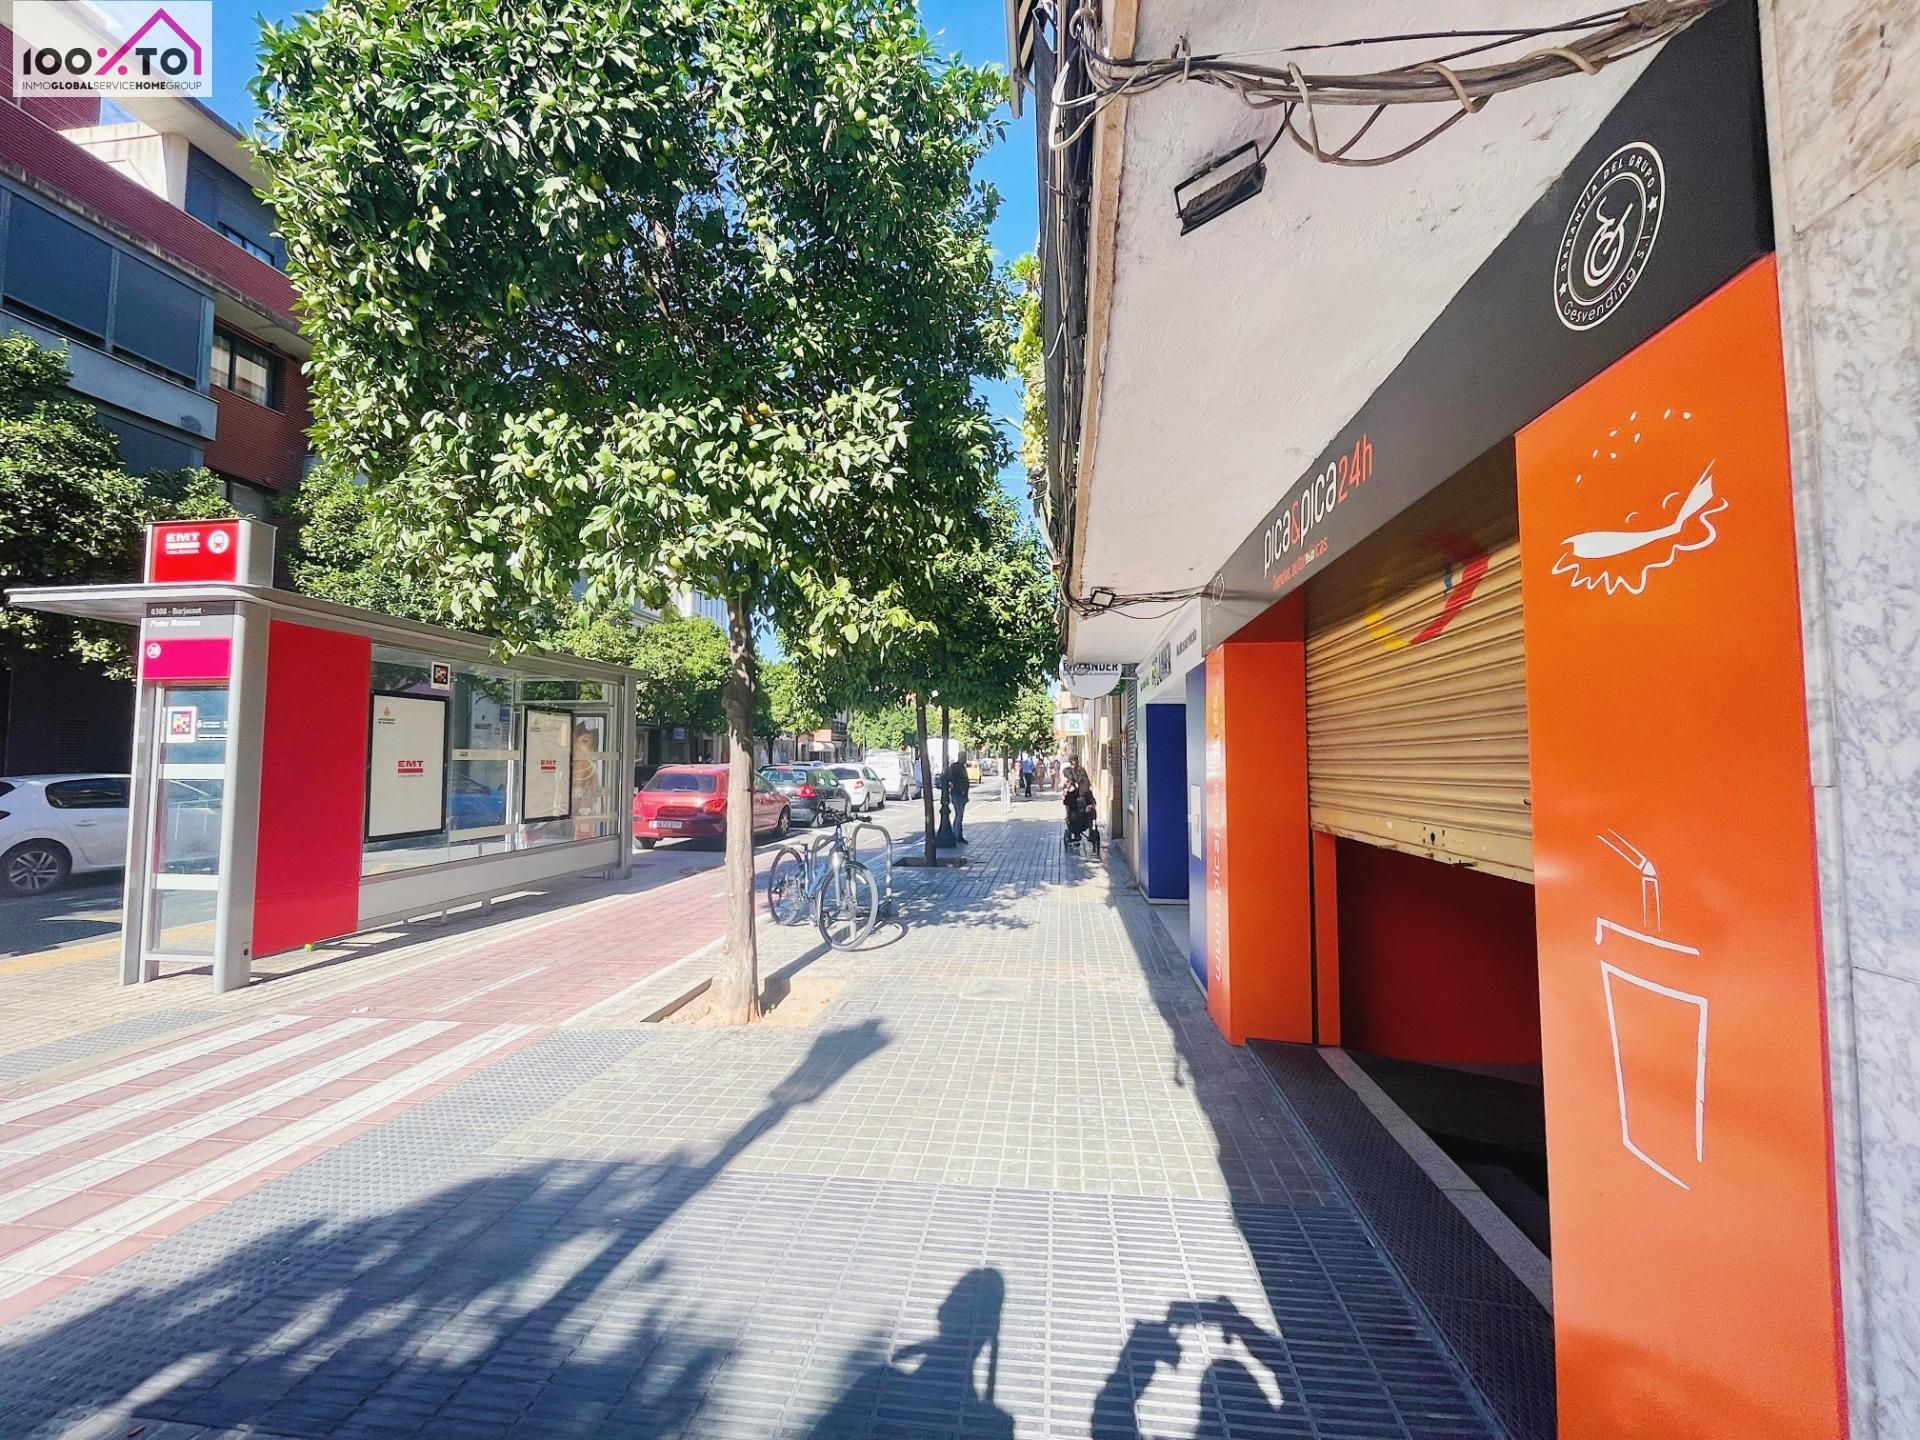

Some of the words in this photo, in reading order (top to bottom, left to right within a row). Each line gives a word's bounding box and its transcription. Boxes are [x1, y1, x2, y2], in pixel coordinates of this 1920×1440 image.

[1603, 157, 1625, 181] DEL
[1628, 153, 1656, 189] GRUPO
[1563, 267, 1637, 323] Gesvending
[166, 532, 200, 542] EMT
[397, 760, 424, 768] EMT
